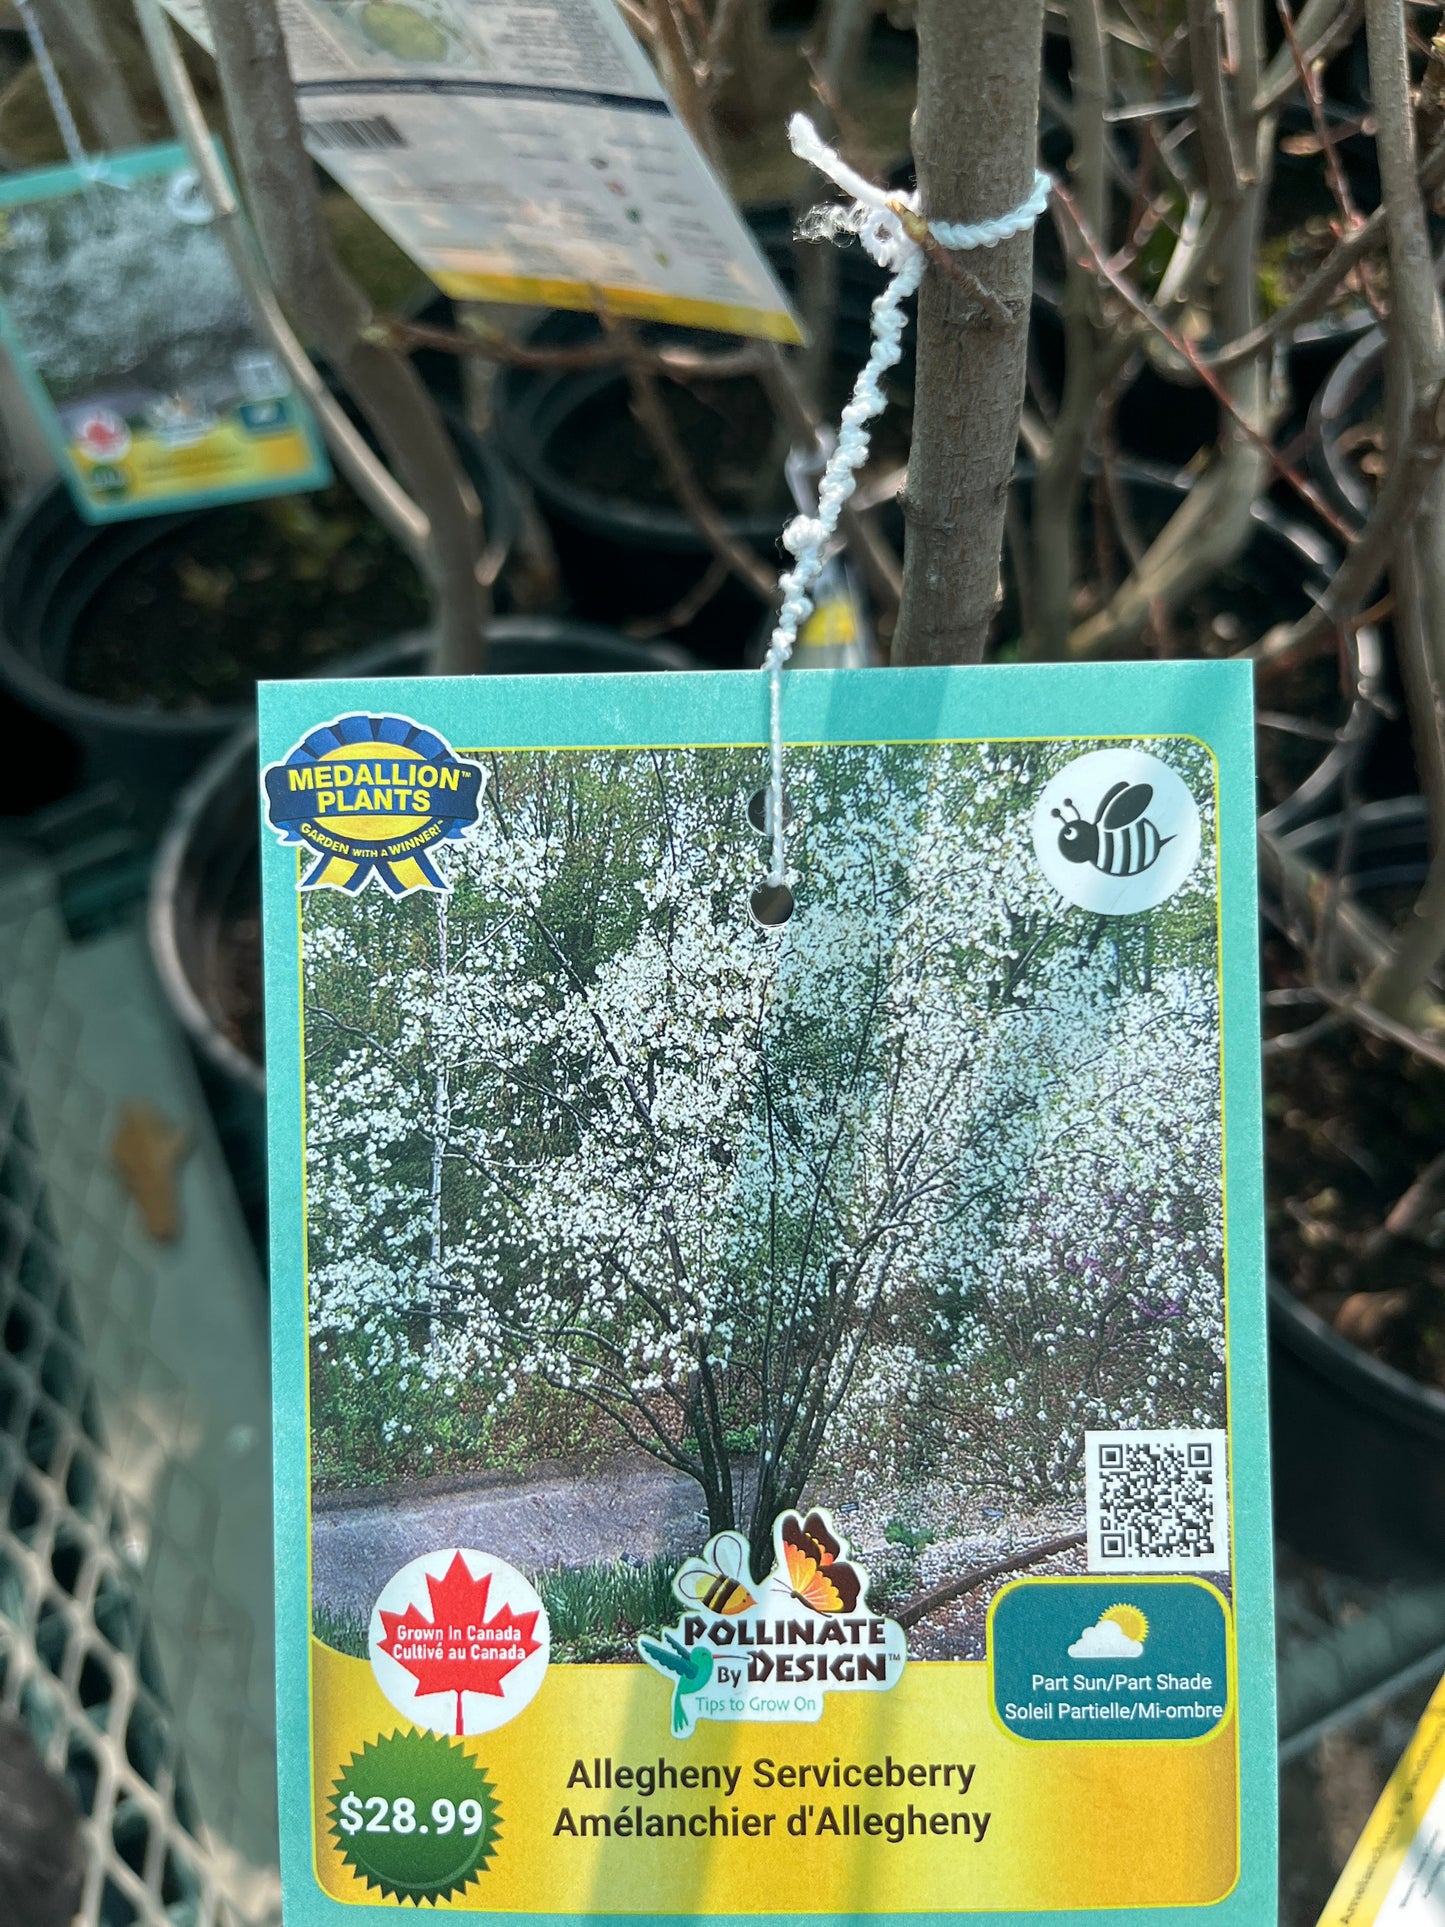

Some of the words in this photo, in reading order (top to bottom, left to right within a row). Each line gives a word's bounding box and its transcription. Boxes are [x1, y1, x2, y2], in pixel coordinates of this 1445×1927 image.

[317, 788, 431, 813] PLANTS
[301, 822, 350, 855] GARDEN
[352, 848, 378, 858] WITH
[381, 849, 388, 857] A
[388, 823, 442, 856] WINNER!
[397, 1625, 444, 1641] Grown
[448, 1625, 462, 1641] In
[466, 1624, 521, 1641] Canada
[684, 1615, 886, 1646] POLLINATE
[392, 1642, 444, 1660] Cultivé
[448, 1647, 467, 1660] au
[470, 1643, 526, 1660] Canada
[717, 1666, 741, 1688] By
[1032, 1675, 1068, 1691] Part
[1073, 1674, 1152, 1692] Sun/Part
[1156, 1673, 1212, 1690] Shade
[695, 1697, 725, 1714] Tips
[730, 1698, 744, 1711] to
[749, 1697, 790, 1712] Grow
[794, 1697, 816, 1711] On
[1005, 1702, 1053, 1720] Soleil
[1058, 1701, 1224, 1720] Partielle/Mi-ombre
[566, 1757, 742, 1796] Allegheny
[753, 1755, 976, 1794] Serviceberry
[339, 1791, 483, 1836] $28.99
[552, 1805, 776, 1837] Amélanchier
[786, 1804, 992, 1842] d'Allegheny
